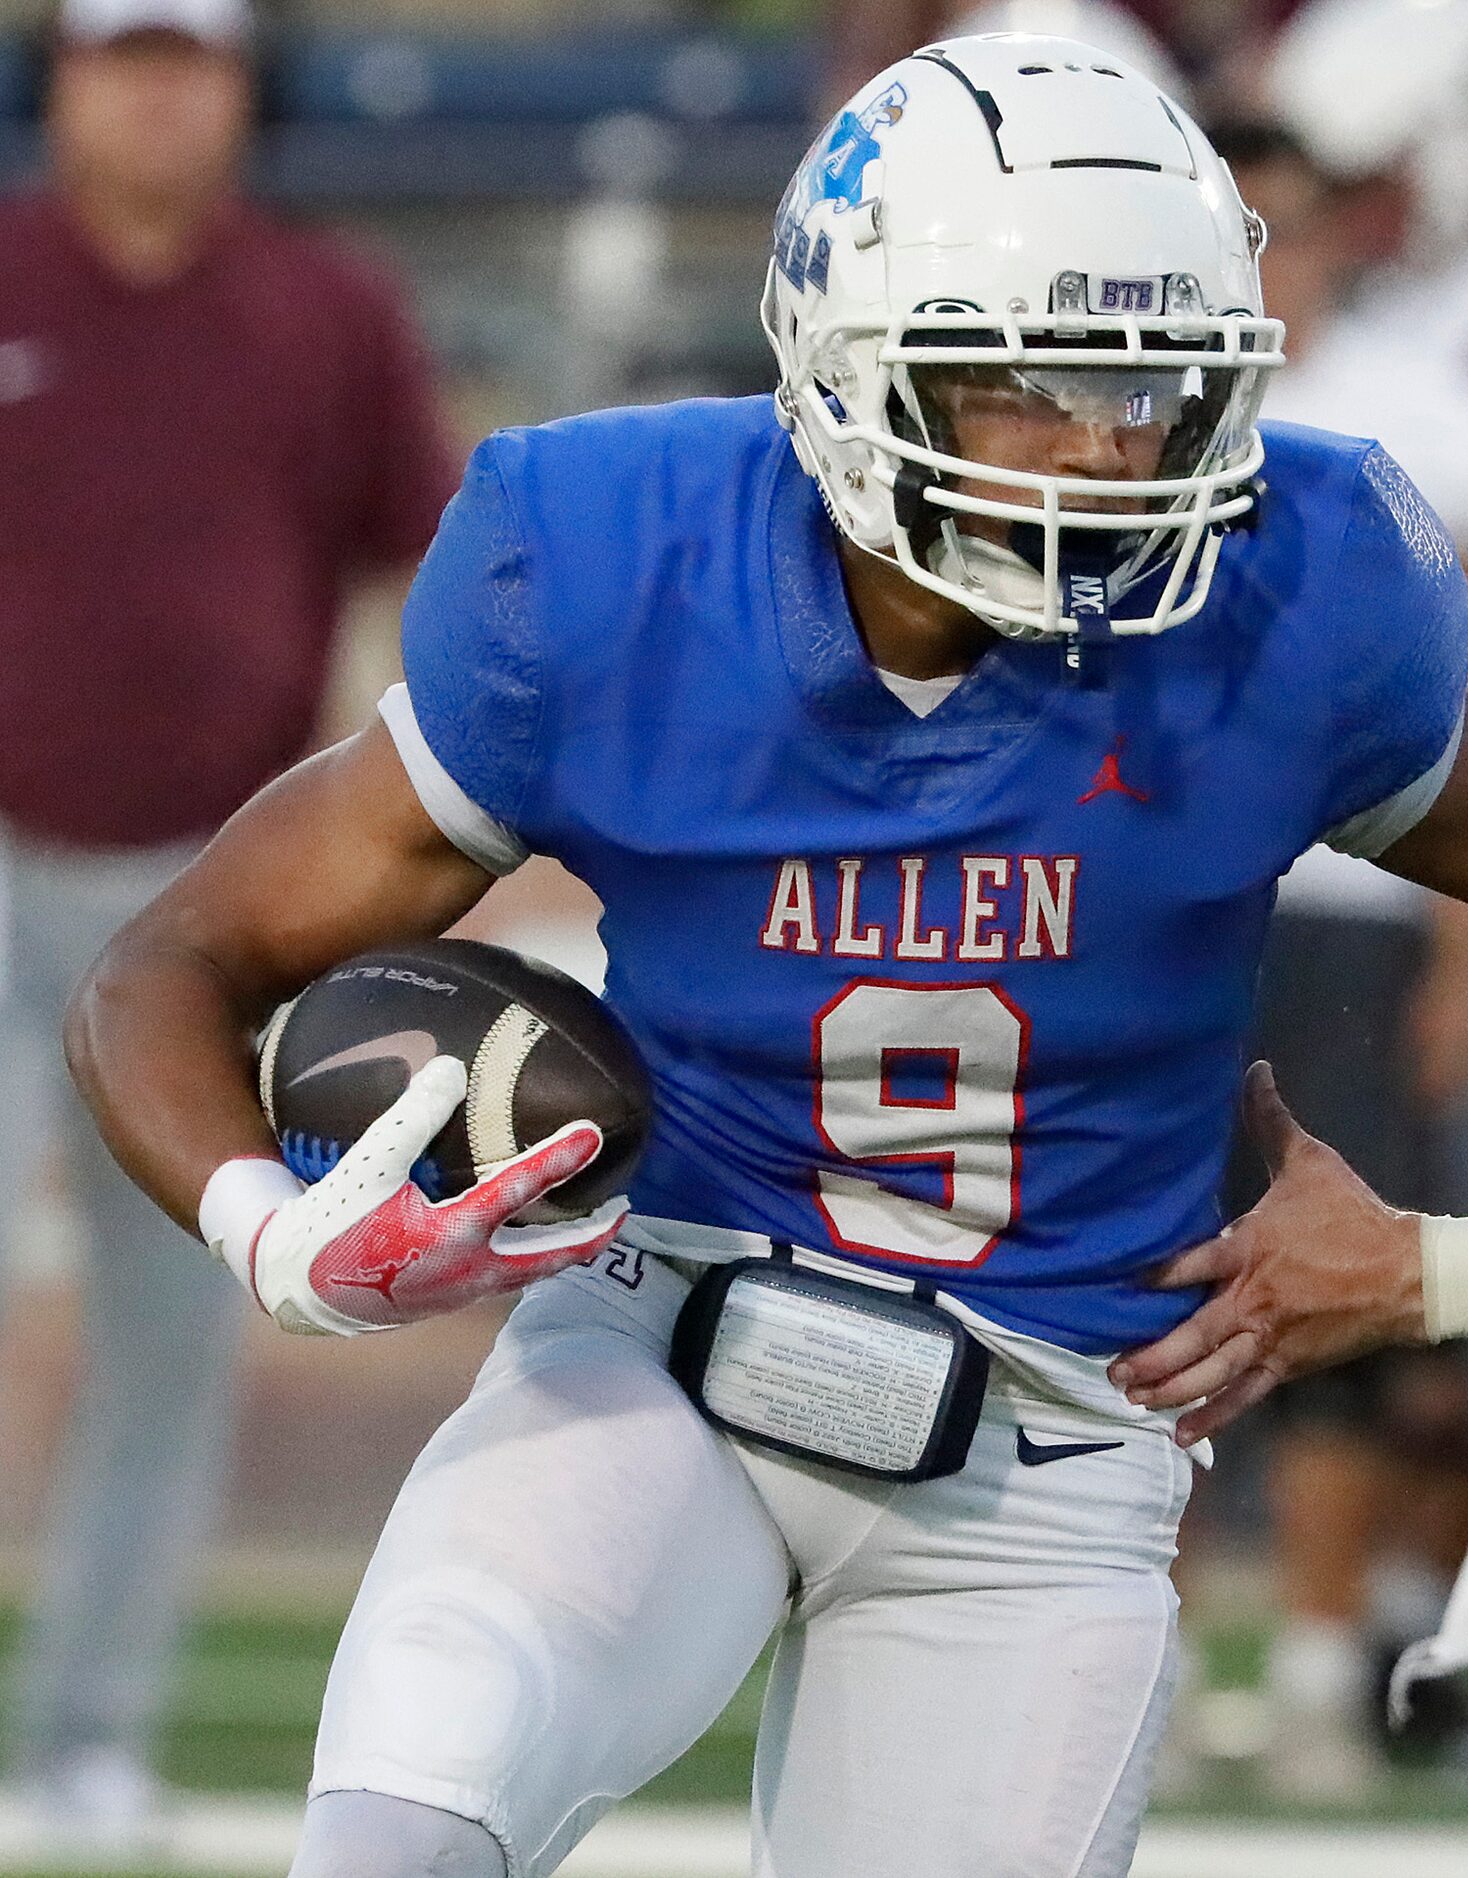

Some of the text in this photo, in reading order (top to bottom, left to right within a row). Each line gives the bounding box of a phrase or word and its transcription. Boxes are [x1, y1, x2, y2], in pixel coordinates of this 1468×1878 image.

[1099, 278, 1154, 311] BTB
[760, 854, 1080, 961] ALLEN
[812, 976, 1032, 1269] 9
